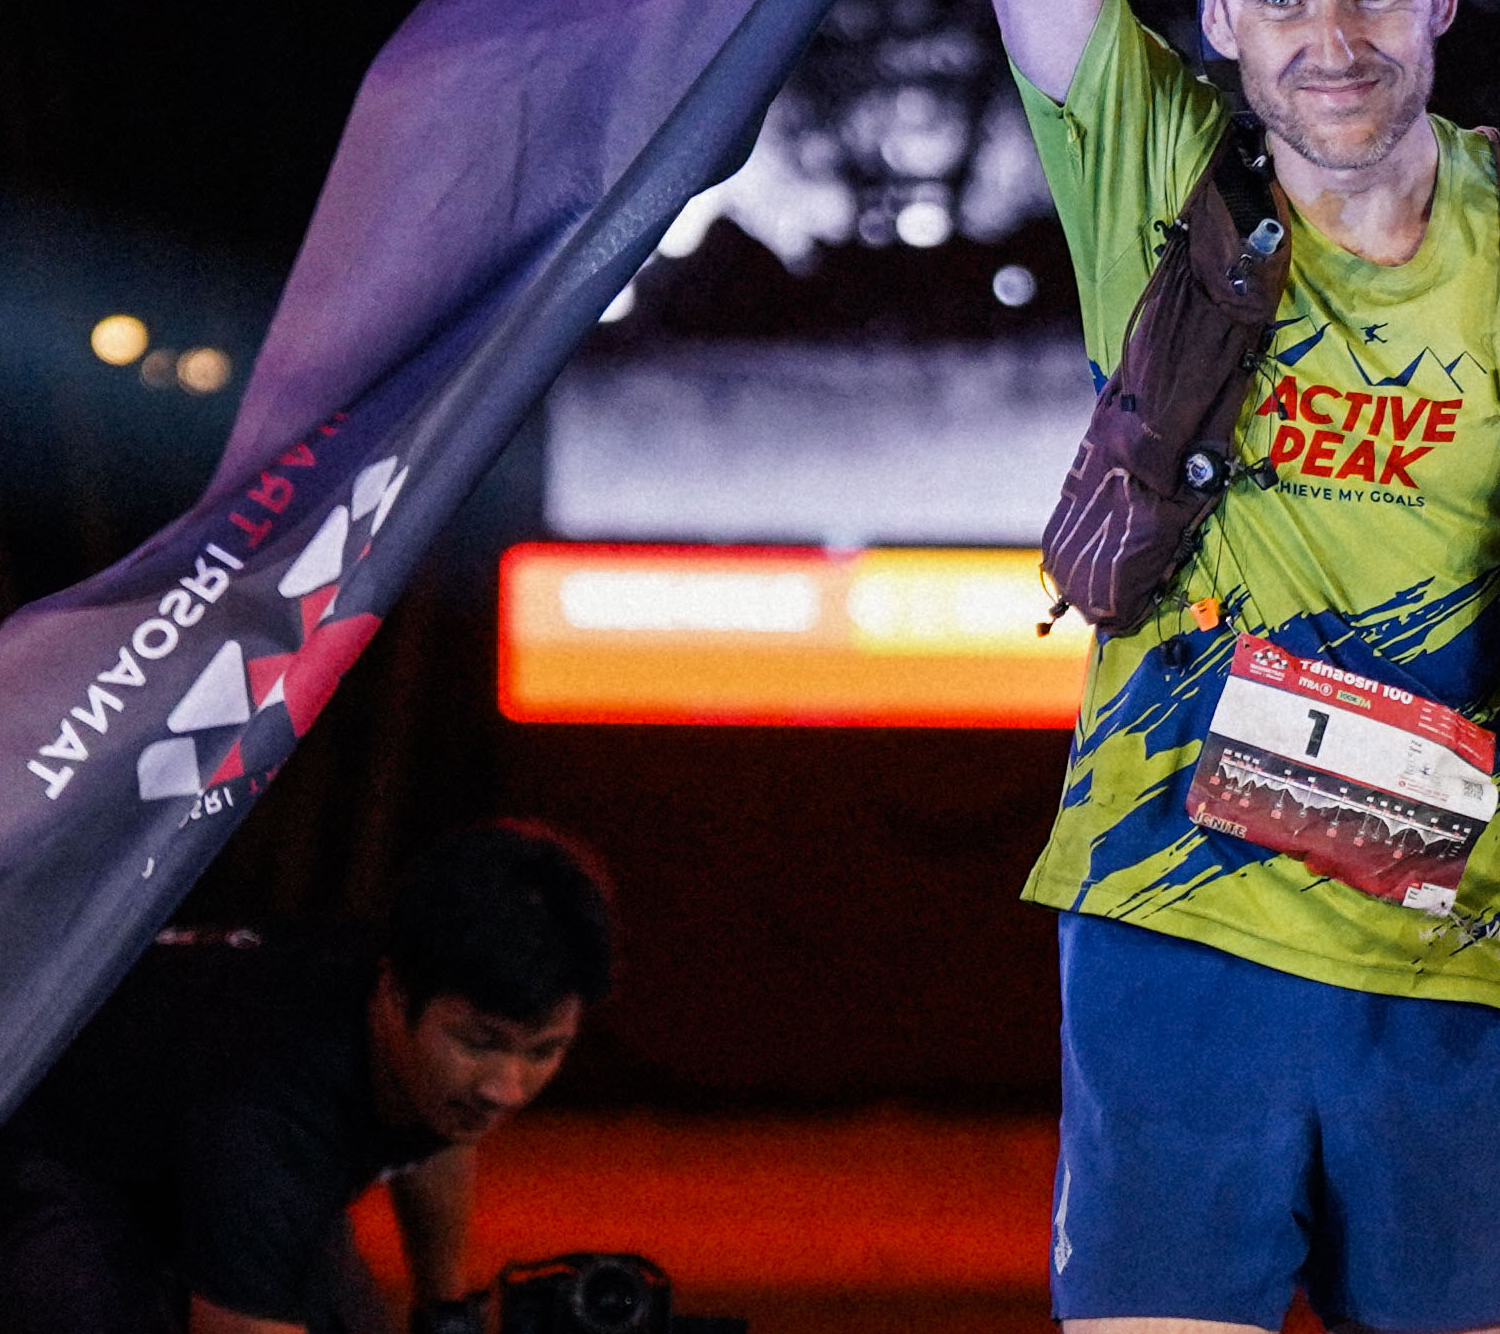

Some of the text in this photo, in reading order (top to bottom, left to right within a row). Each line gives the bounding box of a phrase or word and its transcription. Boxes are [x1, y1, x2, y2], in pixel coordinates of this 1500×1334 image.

[1255, 374, 1463, 443] ACTIVE
[1269, 424, 1438, 489] PEAK
[1338, 488, 1364, 502] MY
[1370, 490, 1426, 508] GOALS
[1382, 683, 1414, 705] 100
[1305, 708, 1330, 758] 1
